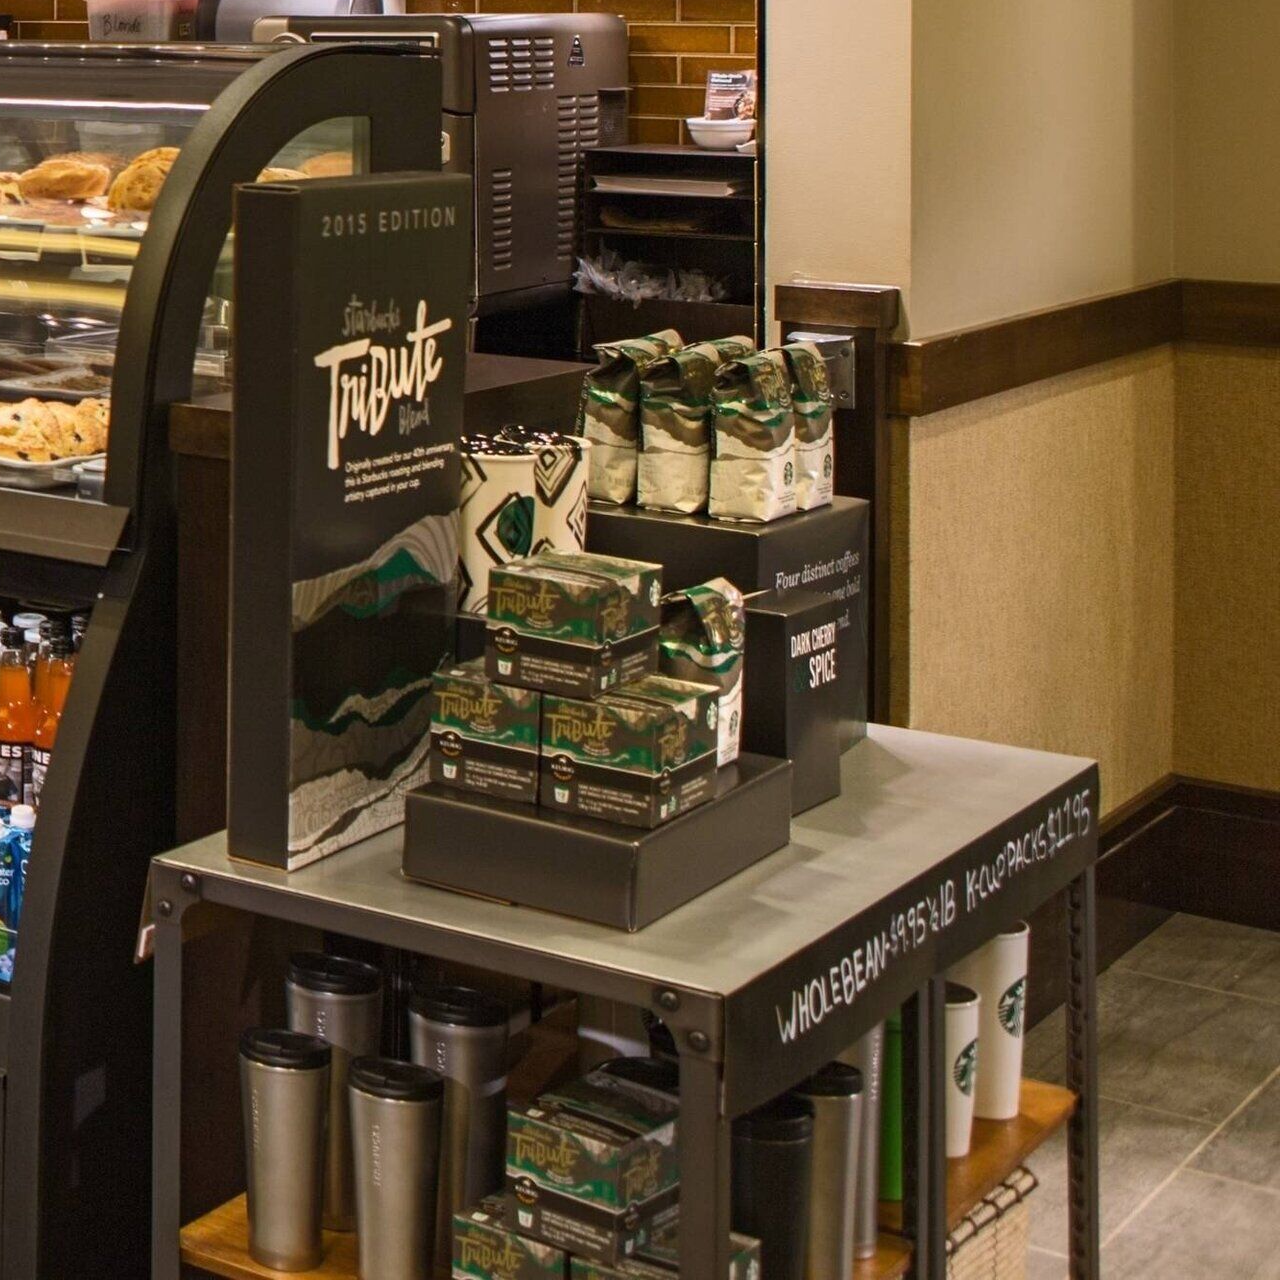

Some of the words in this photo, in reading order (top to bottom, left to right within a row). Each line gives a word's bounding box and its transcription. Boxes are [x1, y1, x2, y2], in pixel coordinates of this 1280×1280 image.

[322, 213, 367, 238] 2015
[379, 207, 455, 233] EDITION
[399, 398, 429, 435] Blend
[775, 572, 800, 589] Four
[801, 560, 834, 583] distinct
[836, 550, 860, 573] coffees
[791, 631, 810, 658] DARK
[812, 621, 836, 650] CHERRY
[810, 648, 836, 688] SPICE
